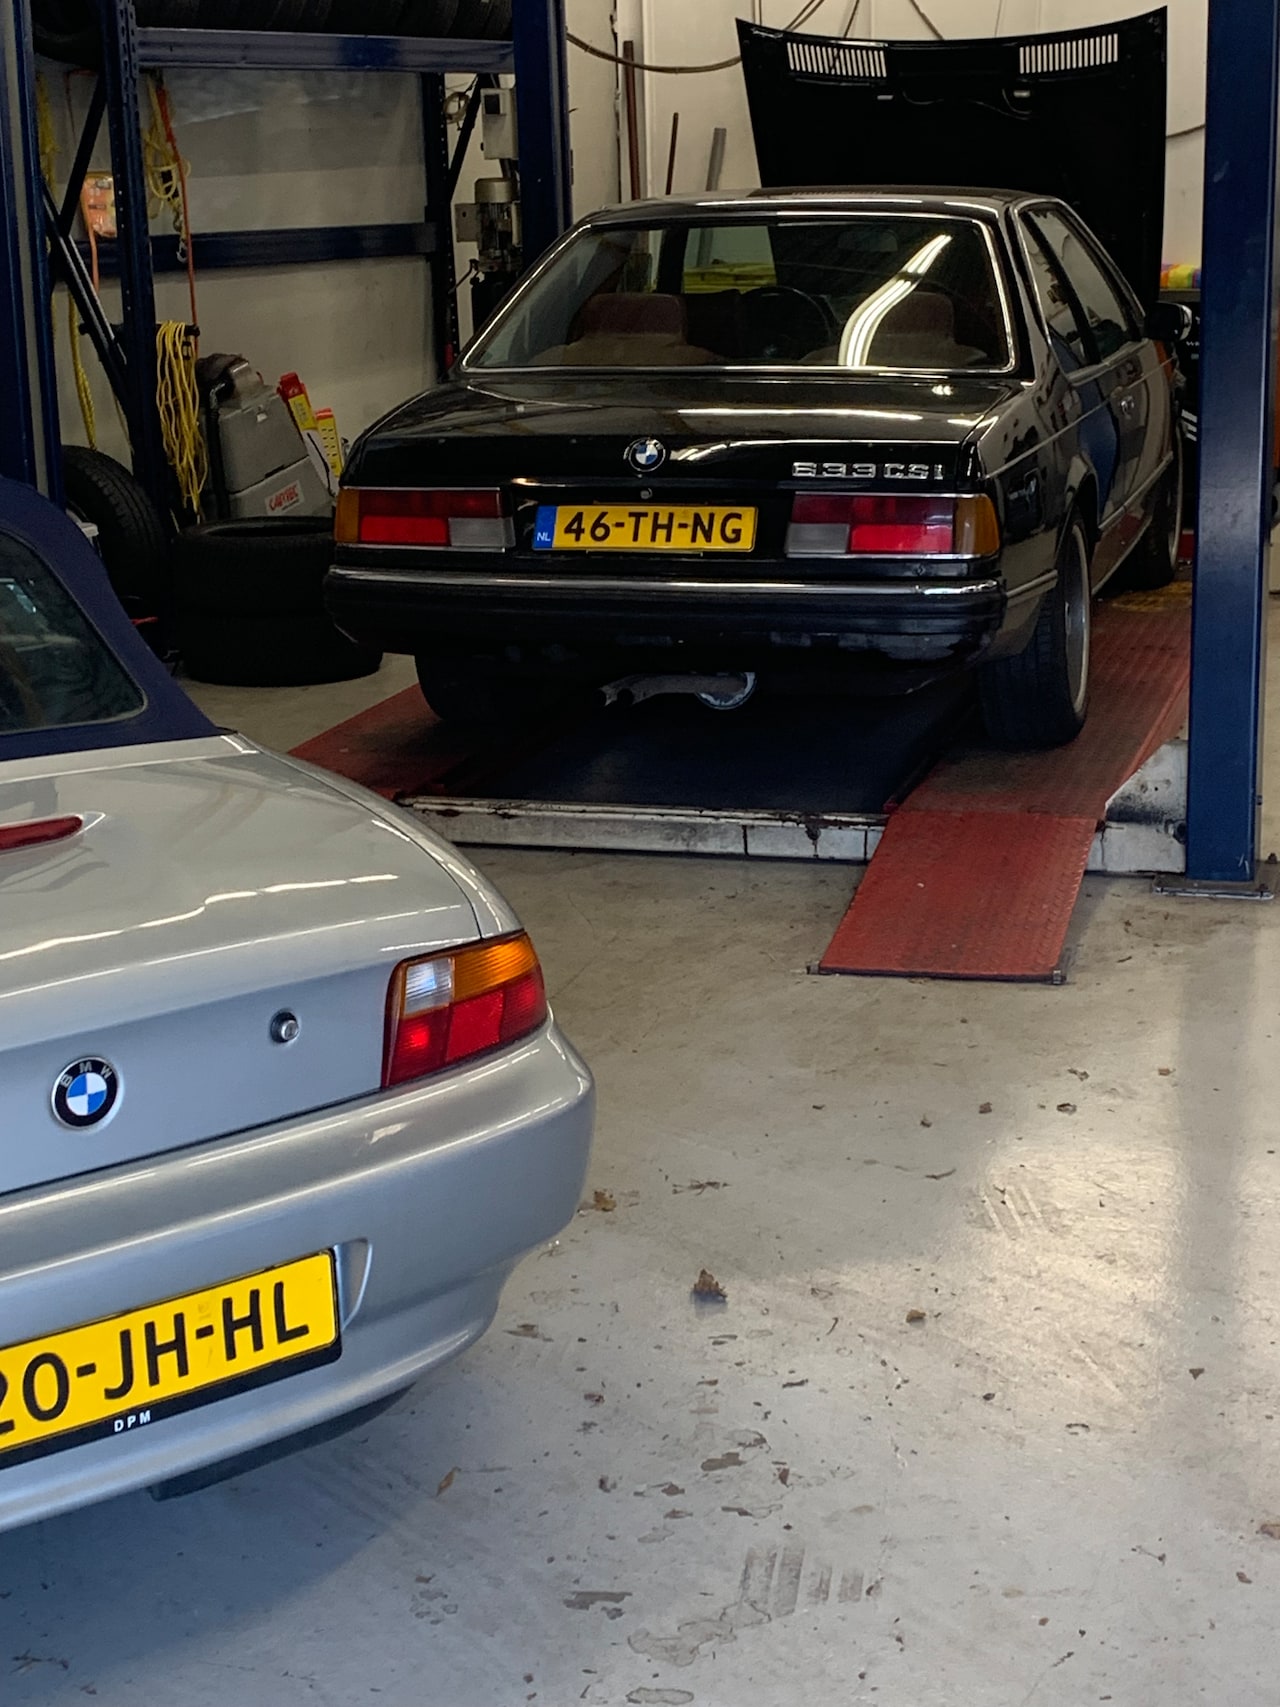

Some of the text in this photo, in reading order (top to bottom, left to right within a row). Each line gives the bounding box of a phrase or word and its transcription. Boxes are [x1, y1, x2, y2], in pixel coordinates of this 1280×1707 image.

[536, 532, 551, 542] NL
[564, 511, 743, 544] 46-TH-NG
[60, 1061, 113, 1088] BMW
[113, 1410, 151, 1433] DPM
